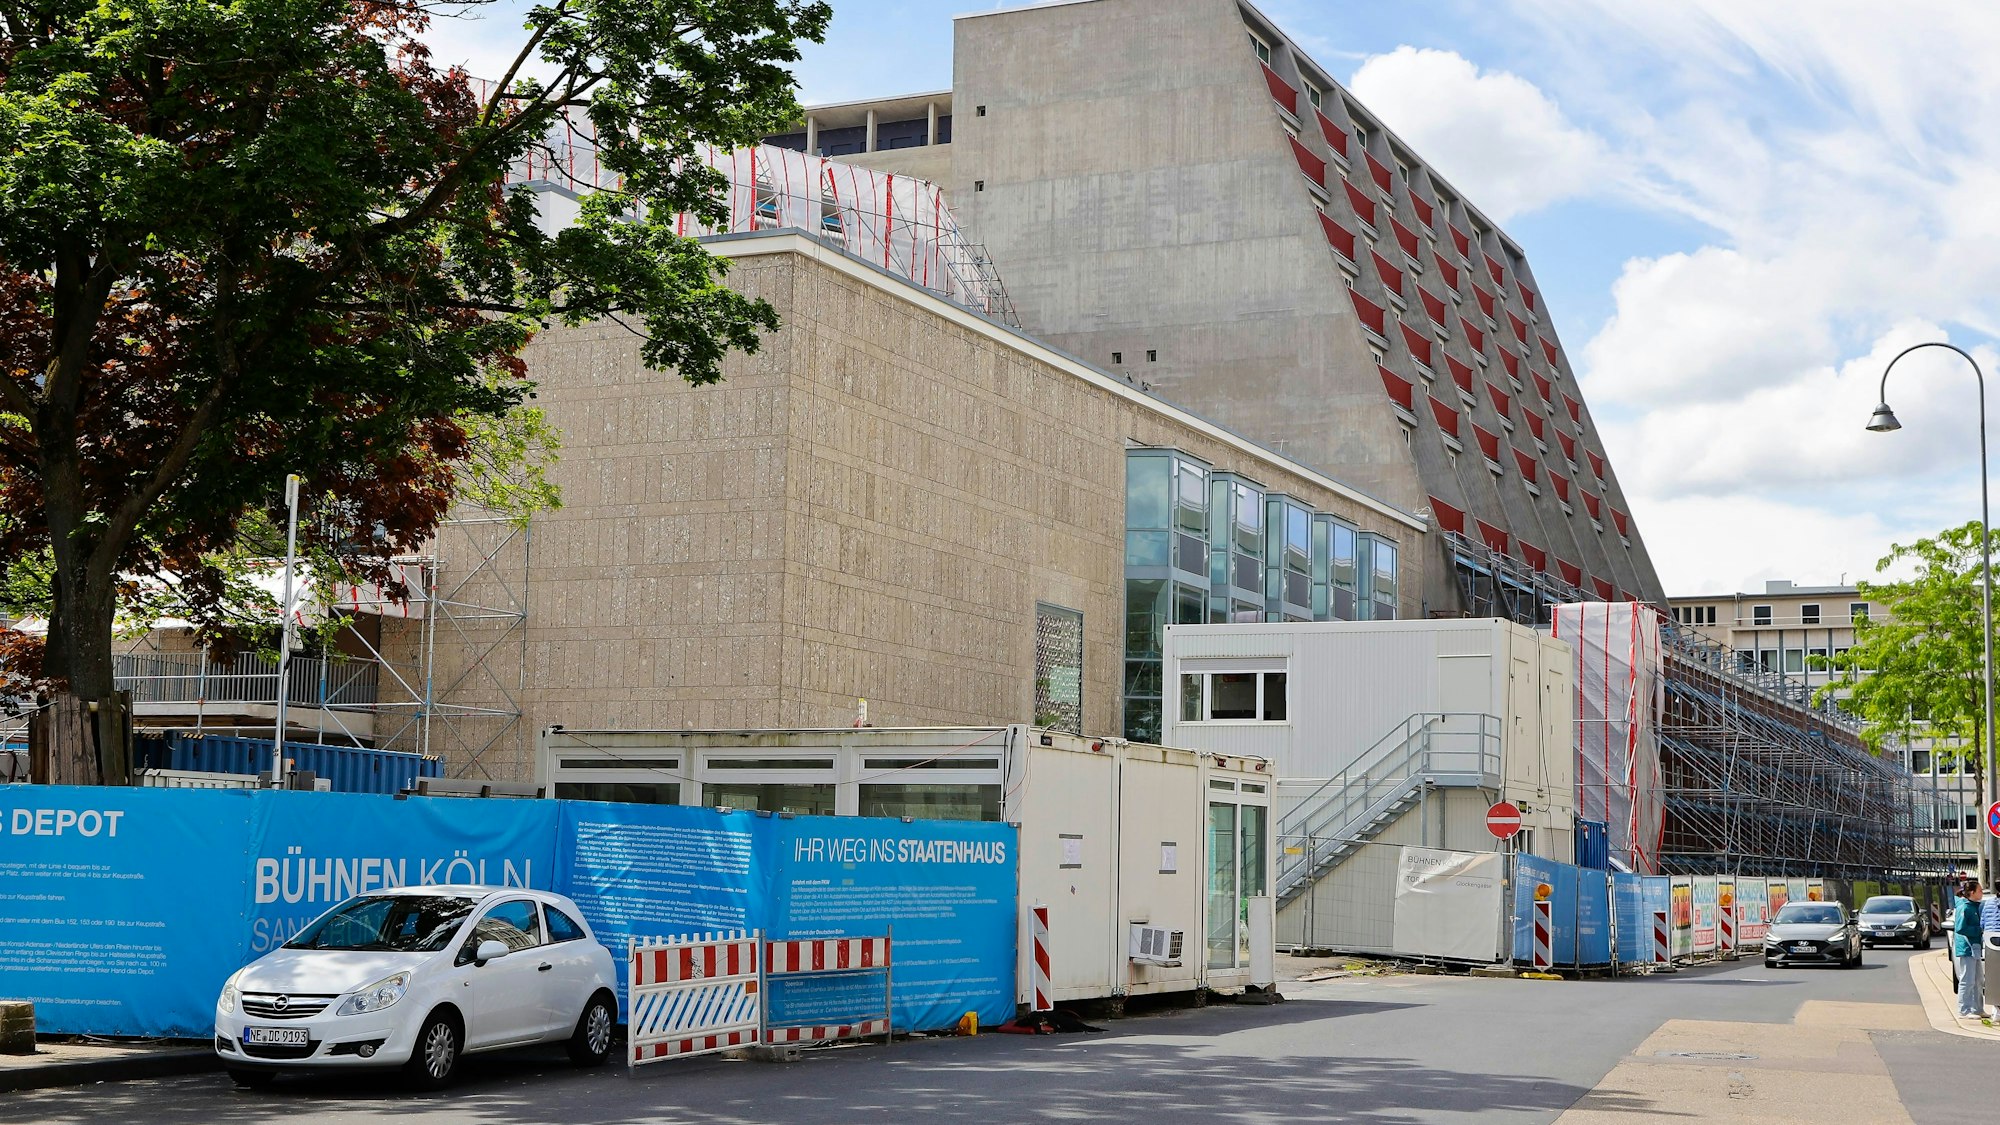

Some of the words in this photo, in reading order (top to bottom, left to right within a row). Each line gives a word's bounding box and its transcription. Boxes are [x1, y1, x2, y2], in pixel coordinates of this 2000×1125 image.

[12, 808, 124, 838] DEPOT
[794, 838, 824, 862] IHR
[828, 838, 866, 862] WEG
[870, 838, 894, 862] INS
[898, 839, 1006, 864] STAATENHAUS
[1408, 854, 1442, 866] BÜHNEN
[255, 846, 406, 904] BÜHNEN
[420, 850, 530, 890] KÖLN
[1456, 880, 1492, 888] Glockengasse
[250, 1029, 262, 1042] NE
[268, 1030, 280, 1042] DC
[282, 1030, 306, 1043] 9193
